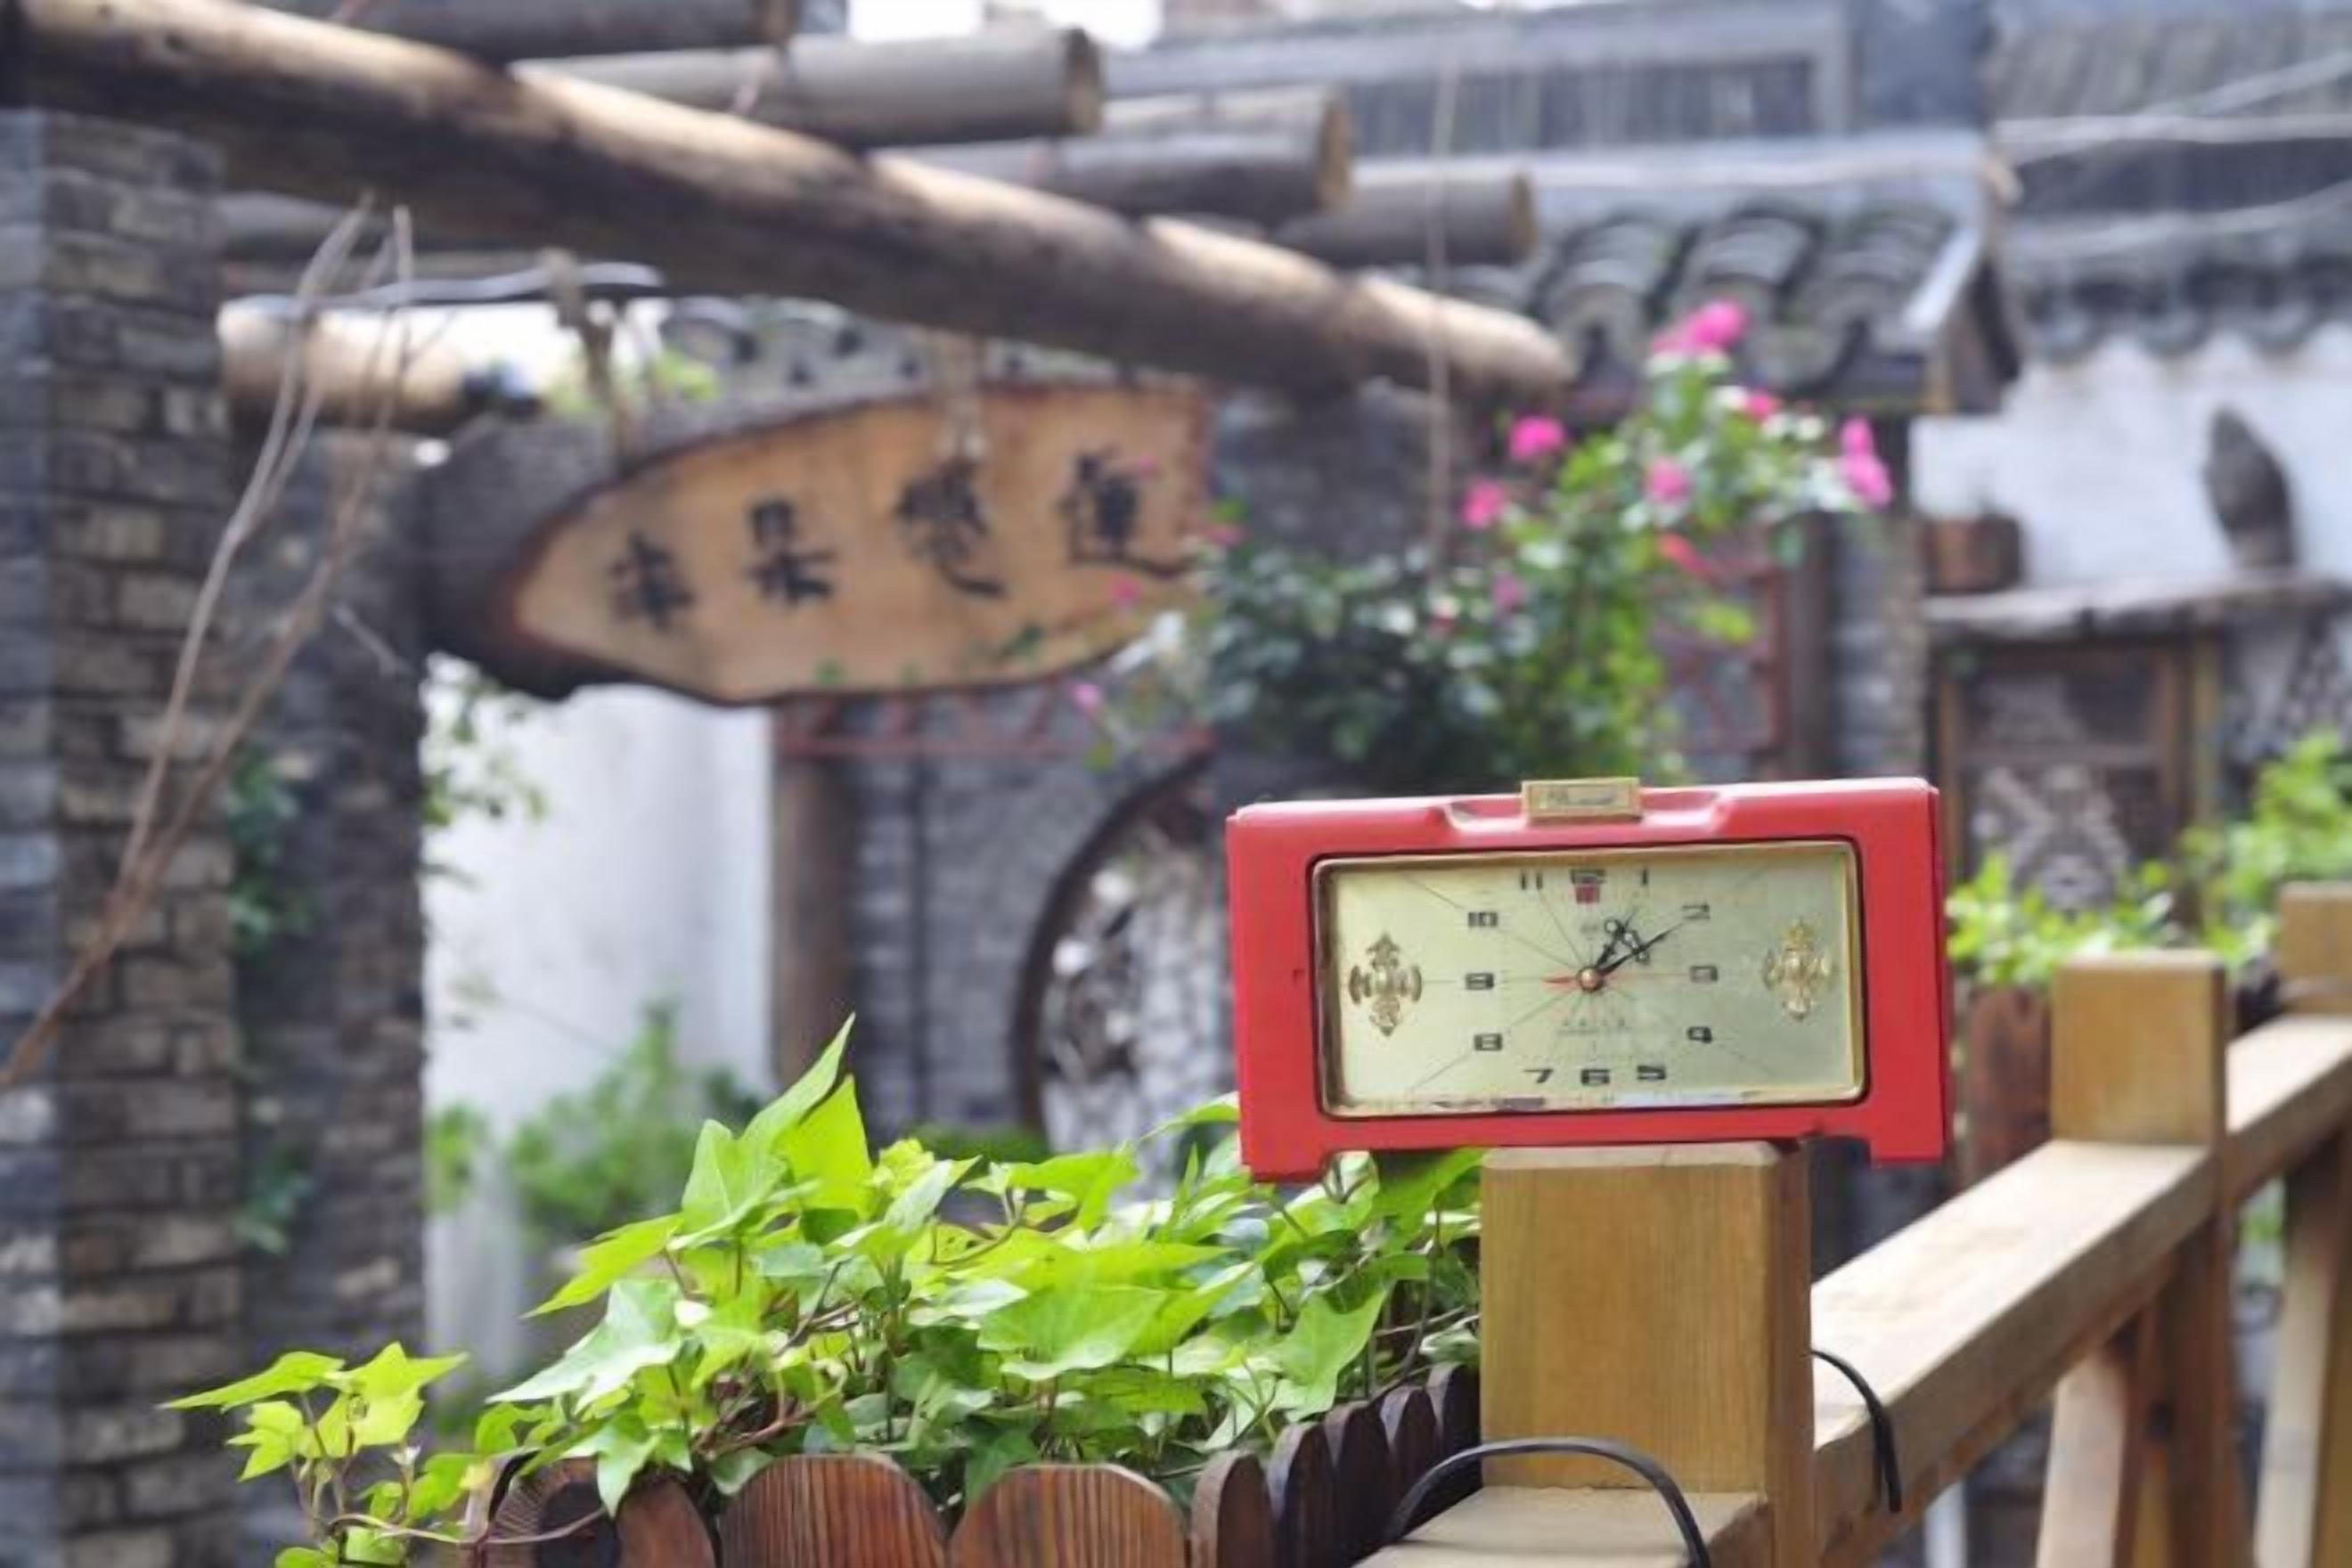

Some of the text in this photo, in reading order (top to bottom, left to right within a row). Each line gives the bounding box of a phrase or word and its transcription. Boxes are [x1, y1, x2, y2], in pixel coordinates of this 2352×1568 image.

[1523, 1067, 1554, 1083] 7
[1580, 1068, 1610, 1085] 6
[1637, 1065, 1666, 1081] 5
